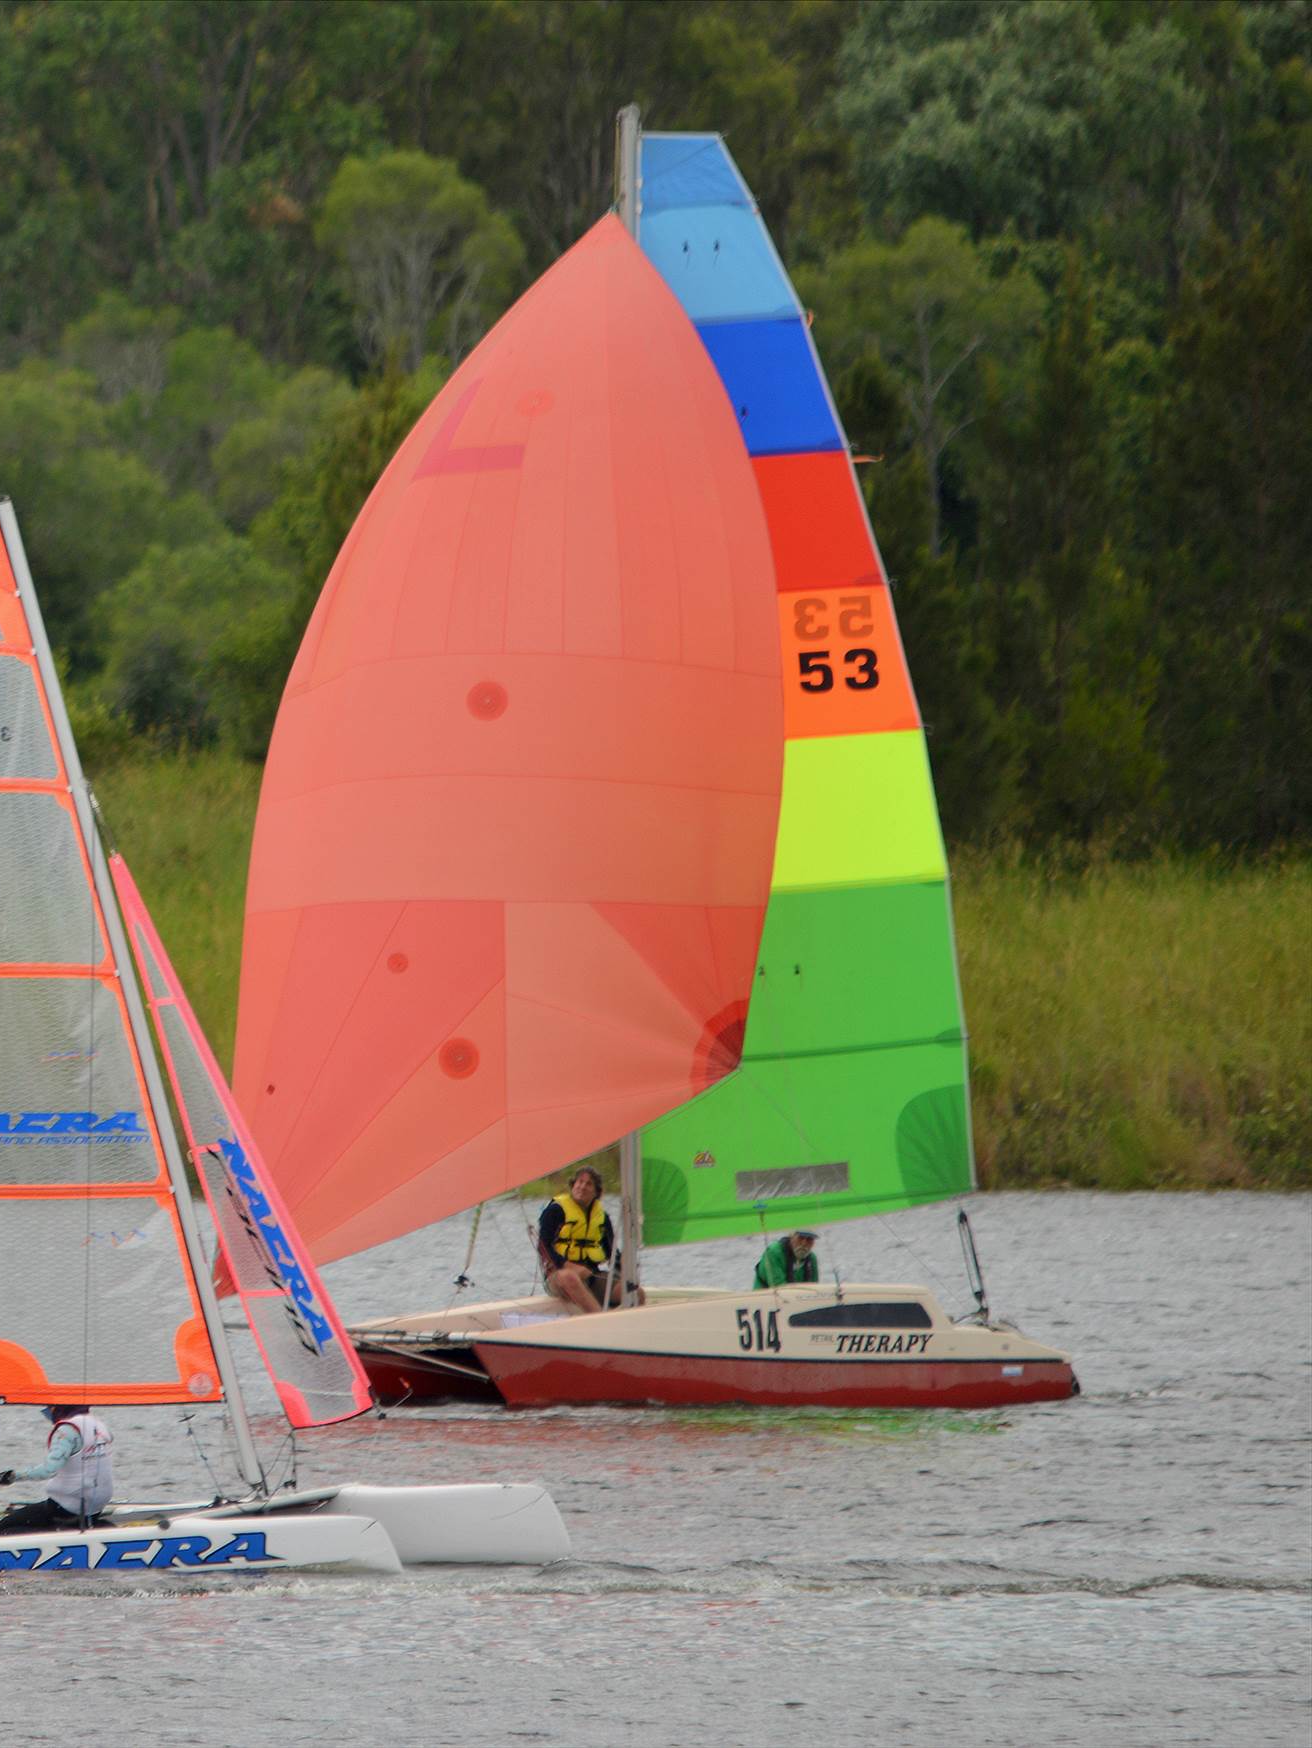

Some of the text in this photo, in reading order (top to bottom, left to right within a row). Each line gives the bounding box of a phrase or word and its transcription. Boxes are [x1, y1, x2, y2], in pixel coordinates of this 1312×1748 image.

[798, 648, 880, 694] 53
[218, 1133, 334, 1357] NACRA
[736, 1307, 782, 1354] 514
[836, 1333, 934, 1354] THERAPY
